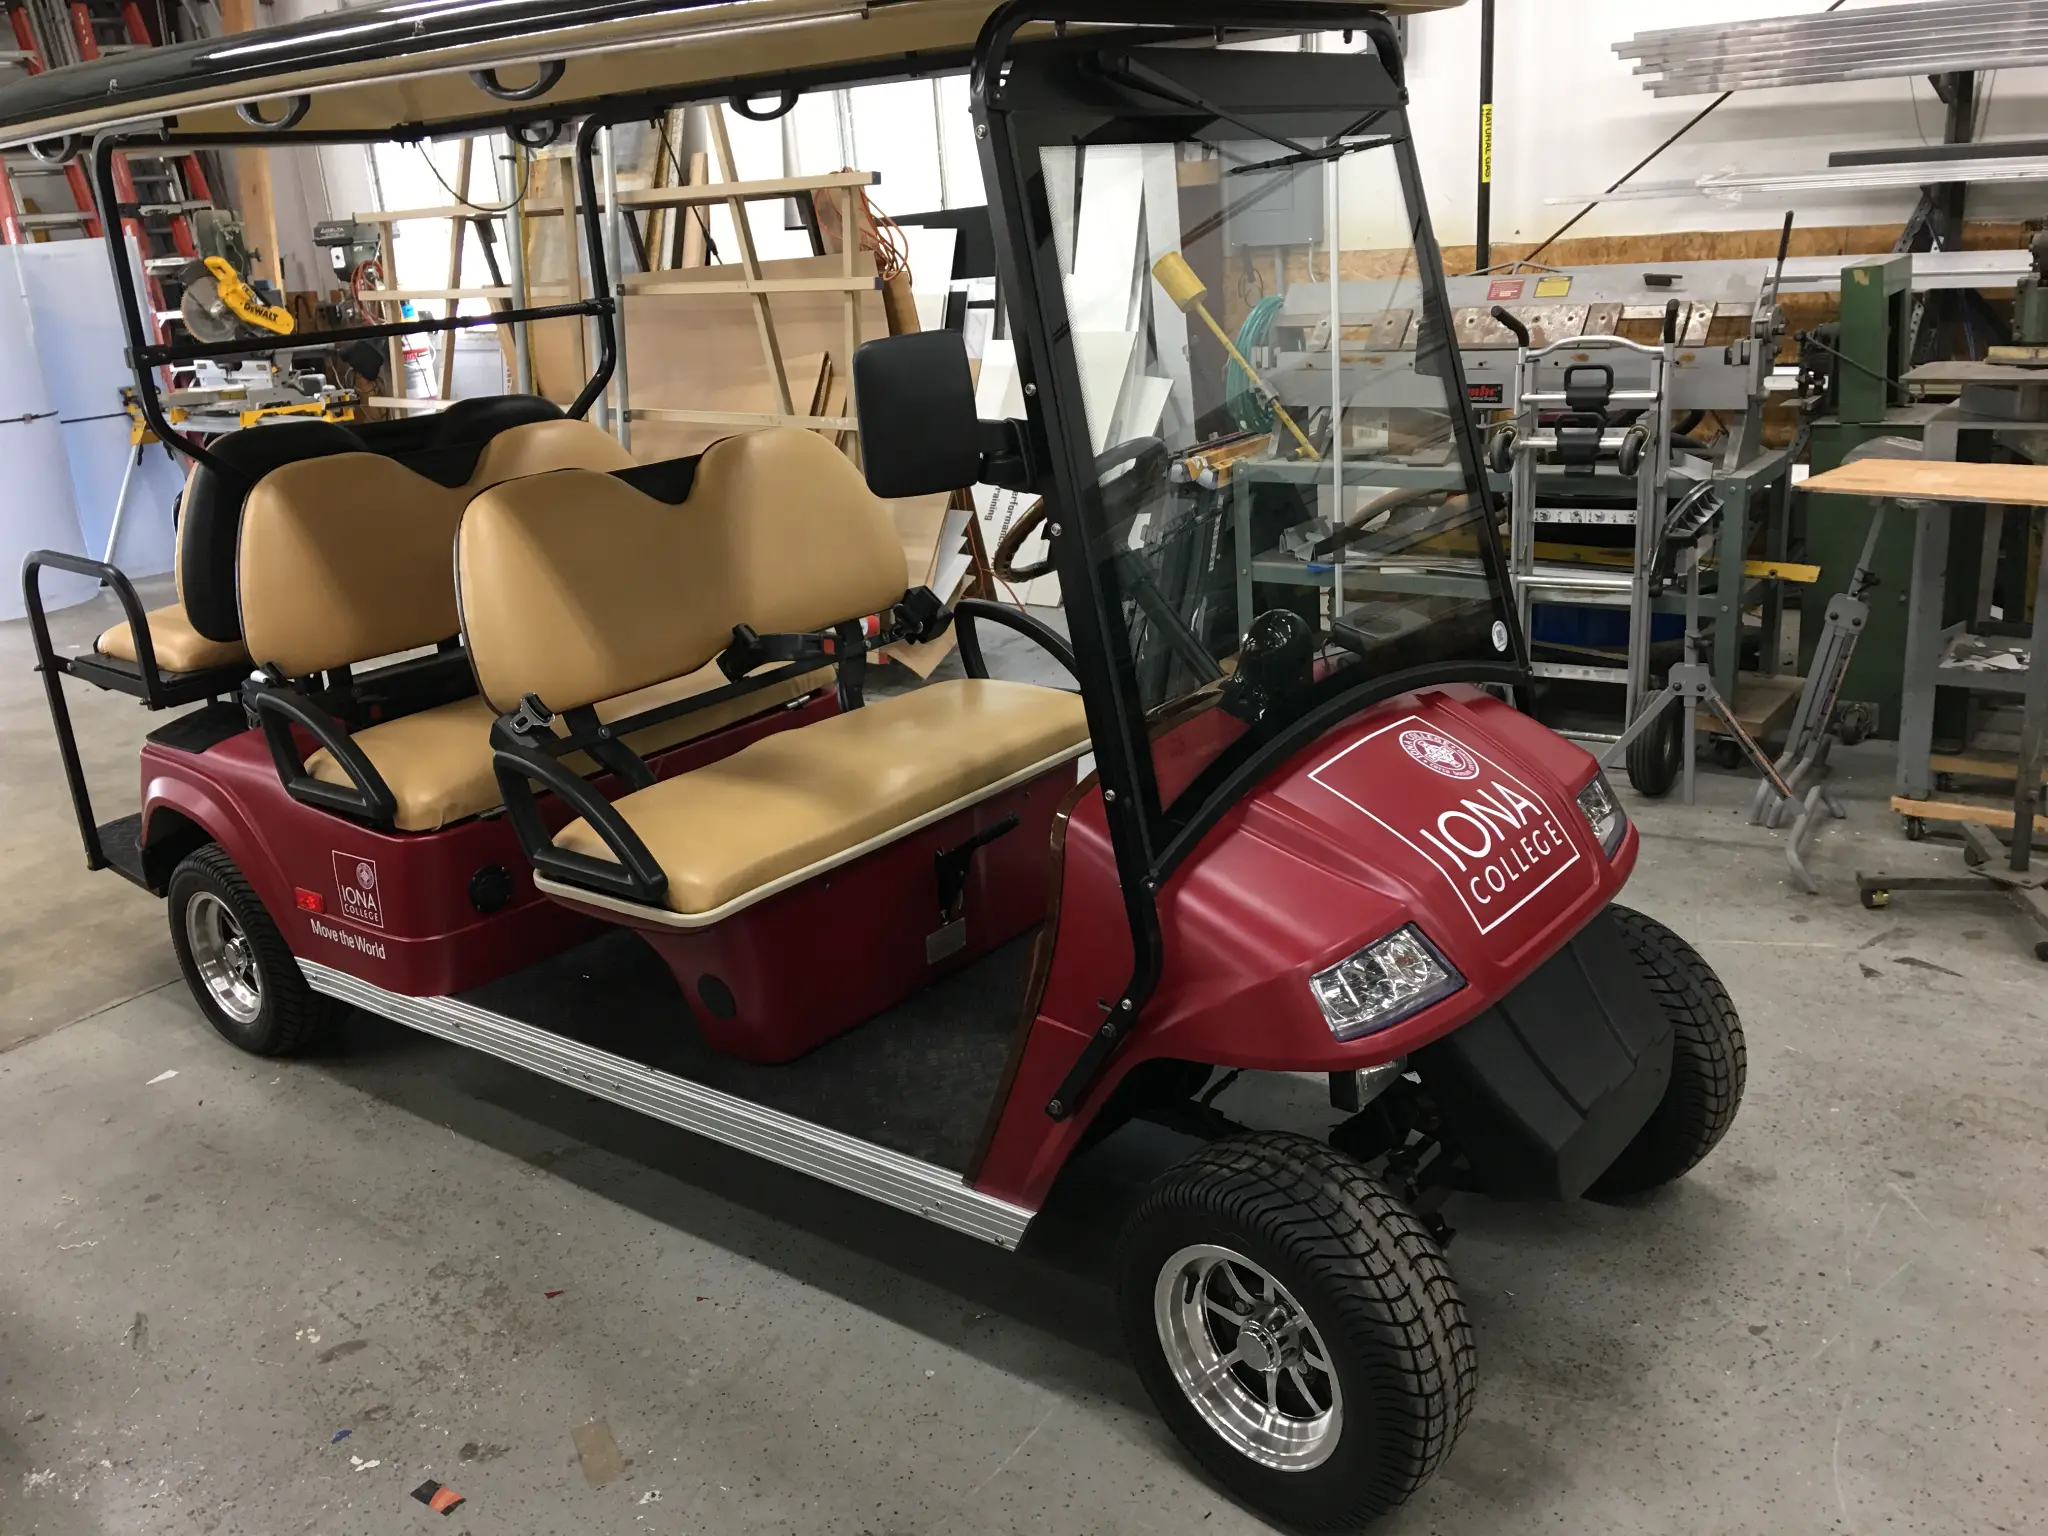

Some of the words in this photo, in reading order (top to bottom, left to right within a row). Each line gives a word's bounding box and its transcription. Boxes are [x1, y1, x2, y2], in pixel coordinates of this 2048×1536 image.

[984, 487, 1001, 521] raining
[997, 490, 1019, 547] erformanc
[1419, 780, 1542, 872] IONA
[1470, 819, 1563, 904] COLLEGE
[341, 885, 377, 911] IONA
[344, 903, 379, 922] COLLEGE
[310, 918, 338, 942] Move
[339, 929, 355, 949] the
[354, 934, 386, 959] World
